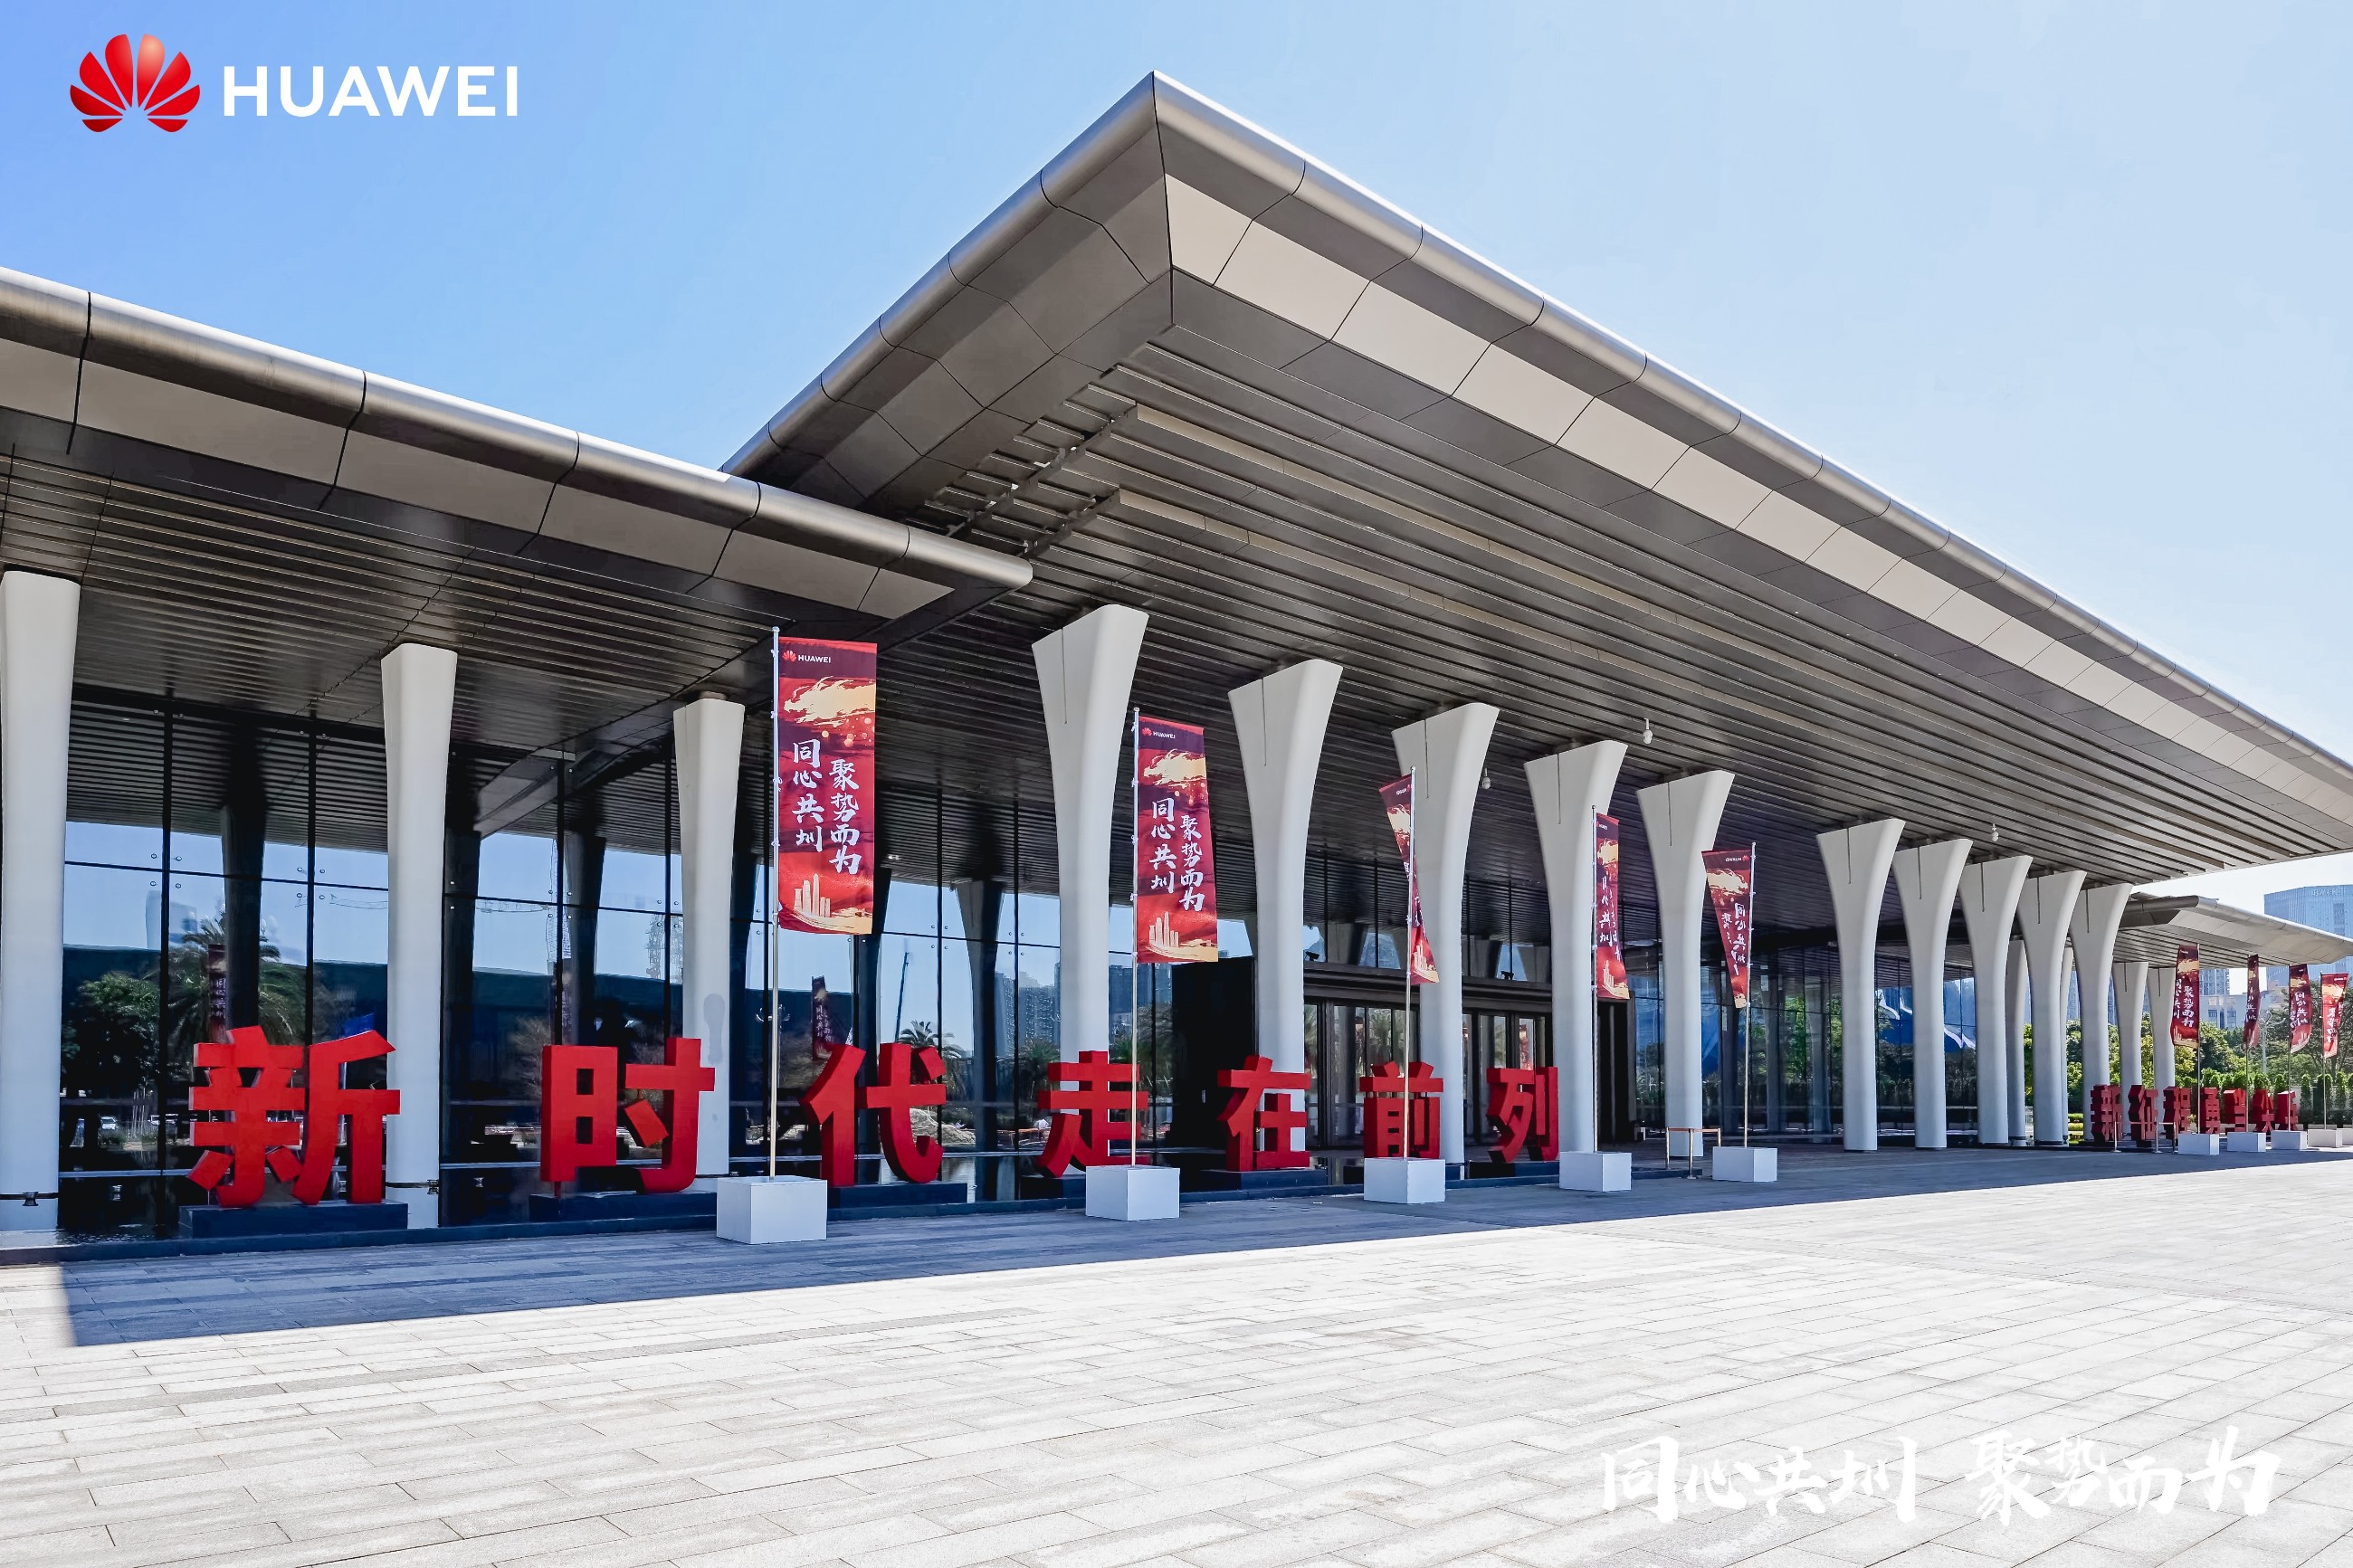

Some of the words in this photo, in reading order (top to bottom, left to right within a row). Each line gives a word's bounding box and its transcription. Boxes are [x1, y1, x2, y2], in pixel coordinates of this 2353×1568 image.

[797, 654, 832, 664] HUAWEI
[1152, 730, 1176, 740] HUAWEI
[792, 737, 825, 853] 同心共圳
[828, 757, 862, 875] 聚势而为
[1148, 797, 1178, 894] 同心共圳
[1178, 814, 1205, 912] 聚势而为
[186, 1025, 1559, 1208] 新时代走在前列
